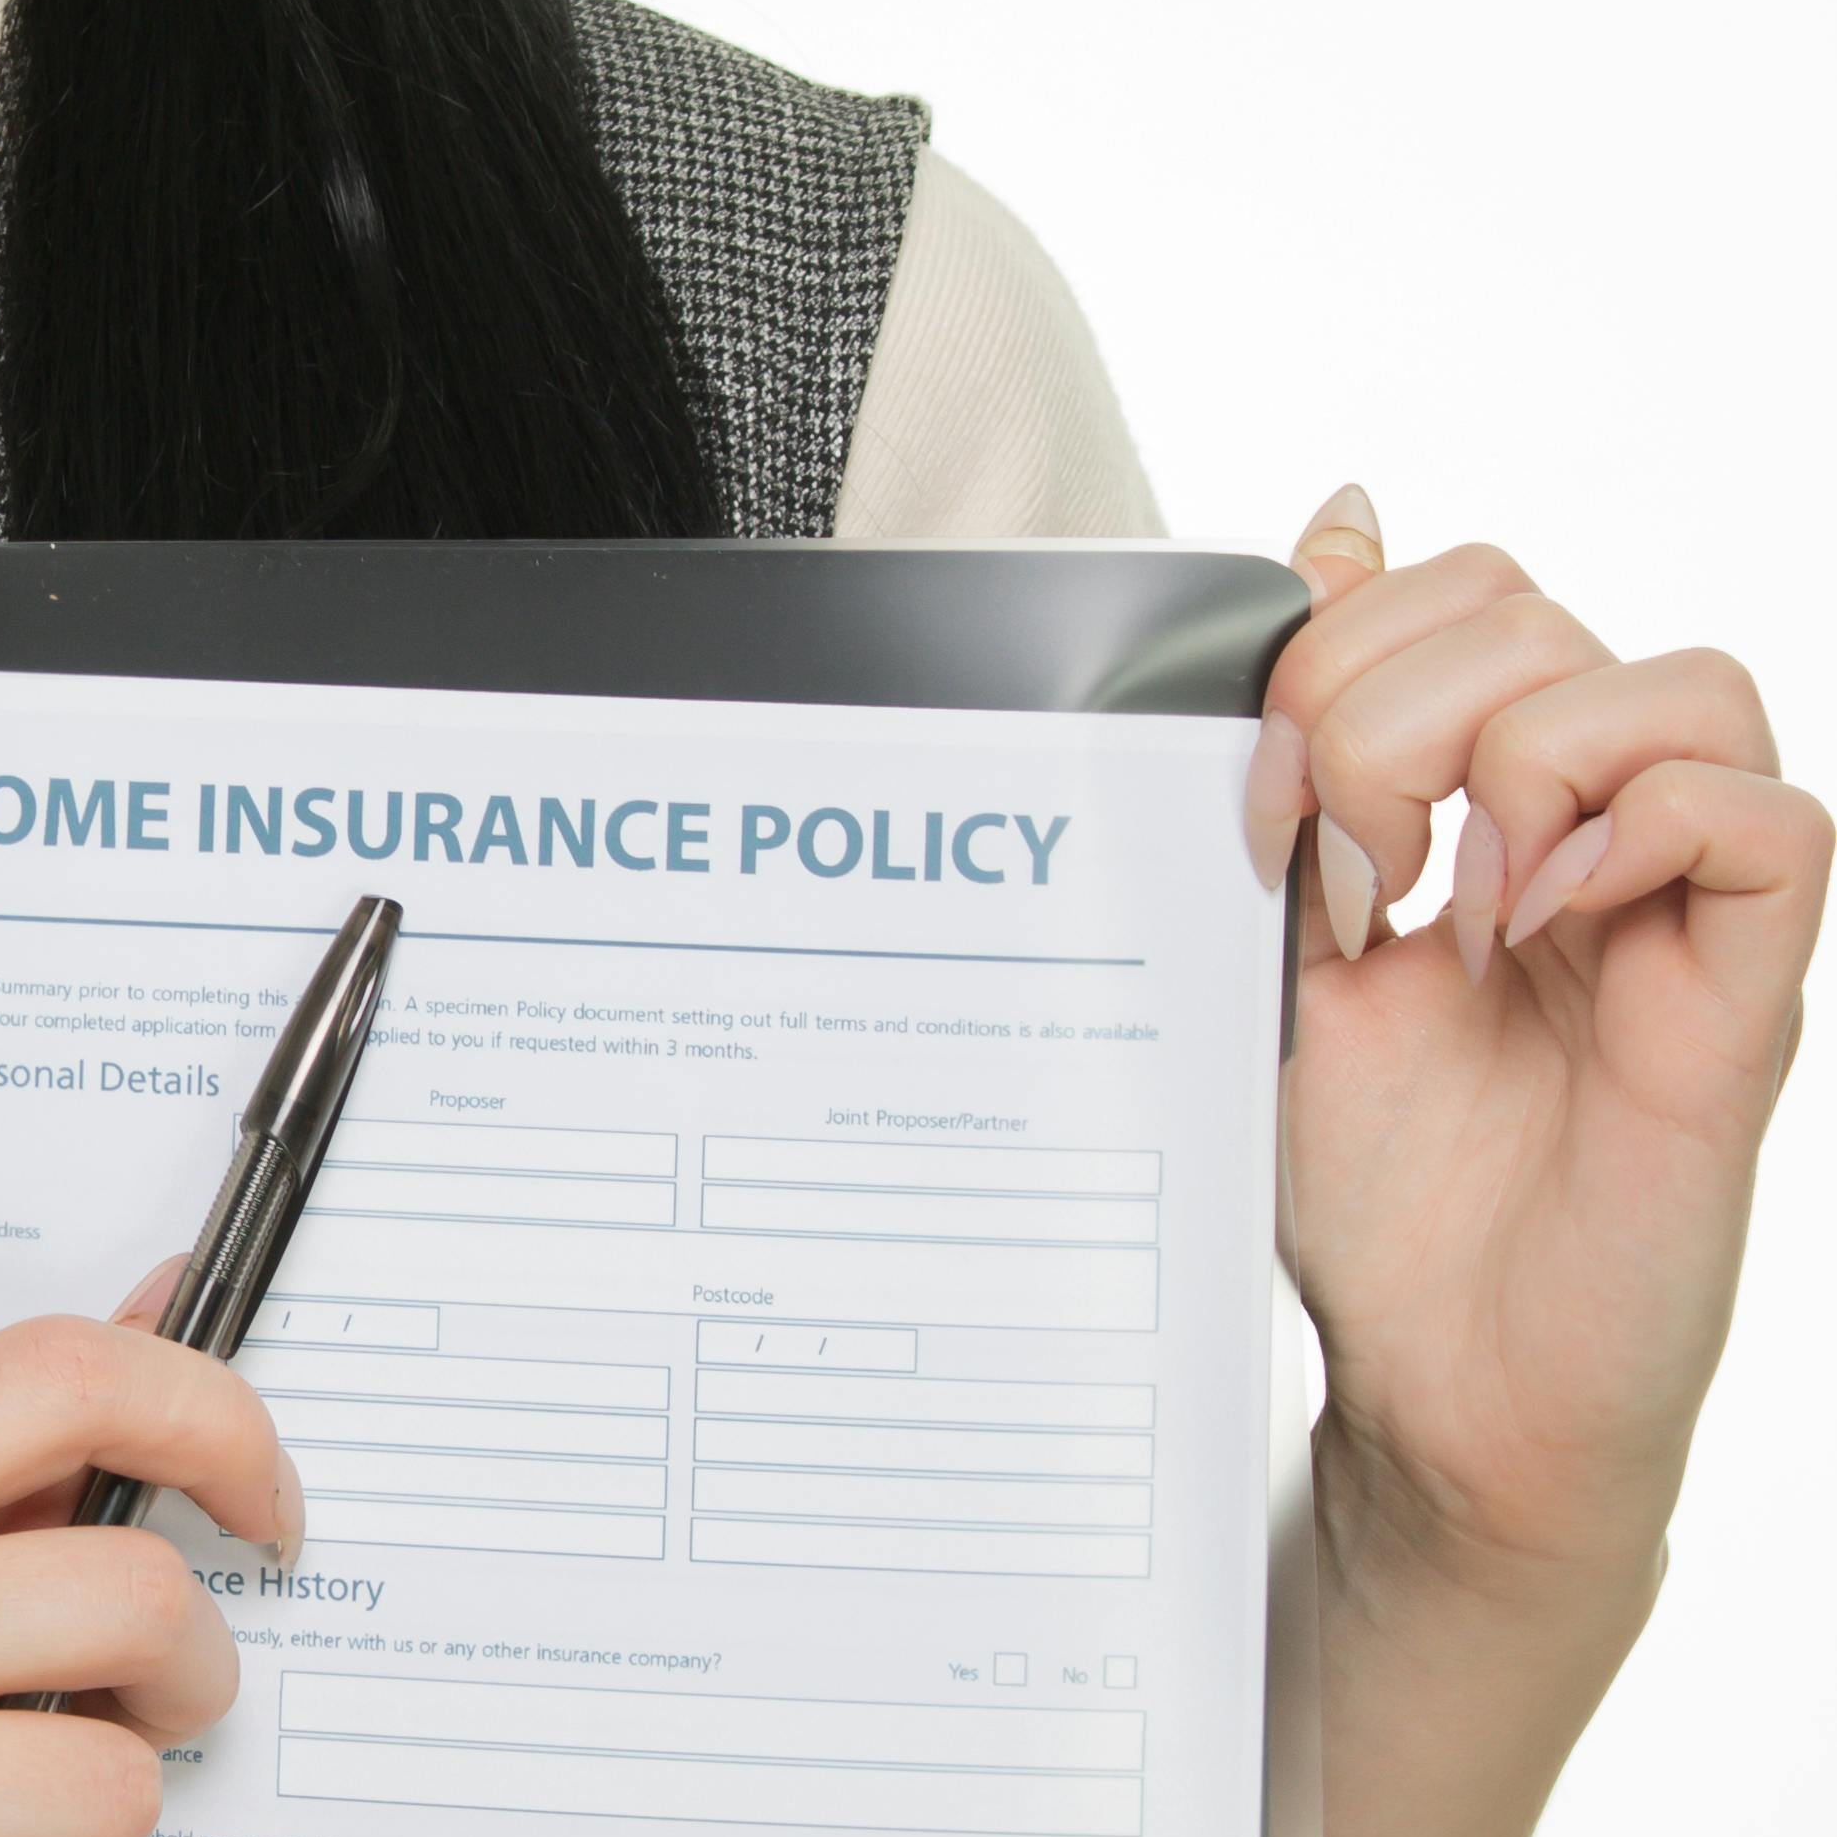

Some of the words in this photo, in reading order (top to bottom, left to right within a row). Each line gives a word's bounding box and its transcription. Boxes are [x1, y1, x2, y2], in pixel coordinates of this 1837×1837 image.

[198, 783, 711, 874] INSURANCE
[739, 804, 1071, 886] POLICY
[78, 985, 120, 1002] prior
[127, 984, 145, 1001] to
[151, 985, 250, 1010] completing
[257, 987, 289, 1007] this
[34, 1012, 126, 1034] completed
[131, 1016, 227, 1038] application
[234, 1019, 276, 1039] form
[404, 995, 419, 1012] A
[425, 1000, 509, 1019] specimen
[516, 1000, 567, 1024] Policy
[573, 1002, 665, 1024] document
[671, 1008, 734, 1032] setting
[739, 1012, 772, 1028] out
[779, 1010, 808, 1030] full
[815, 1014, 868, 1032] terms
[873, 1015, 908, 1034] and
[915, 1018, 1011, 1037] conditions
[1019, 1025, 1032, 1038] is
[1039, 1021, 1075, 1039] also
[1082, 1023, 1159, 1041] available
[427, 1030, 446, 1047] to
[451, 1034, 484, 1052] you
[491, 1031, 502, 1049] if
[509, 1035, 597, 1054] requested
[602, 1037, 660, 1056] within
[666, 1038, 678, 1057] 3
[685, 1042, 758, 1060] months.
[100, 1061, 220, 1097] Details
[429, 1089, 507, 1112] Proposer
[824, 1107, 870, 1127] Joint
[876, 1109, 1028, 1132] Proposer/Partner
[692, 1284, 774, 1306] Postcode
[259, 1566, 385, 1612] History
[290, 1629, 343, 1649] either
[346, 1633, 386, 1652] with
[393, 1639, 414, 1654] us
[419, 1641, 438, 1655] or
[443, 1642, 477, 1661] any
[481, 1641, 531, 1660] other
[536, 1642, 622, 1665] insurance
[628, 1652, 722, 1674] company?
[947, 1662, 979, 1682] Yes
[1062, 1666, 1089, 1685] No
